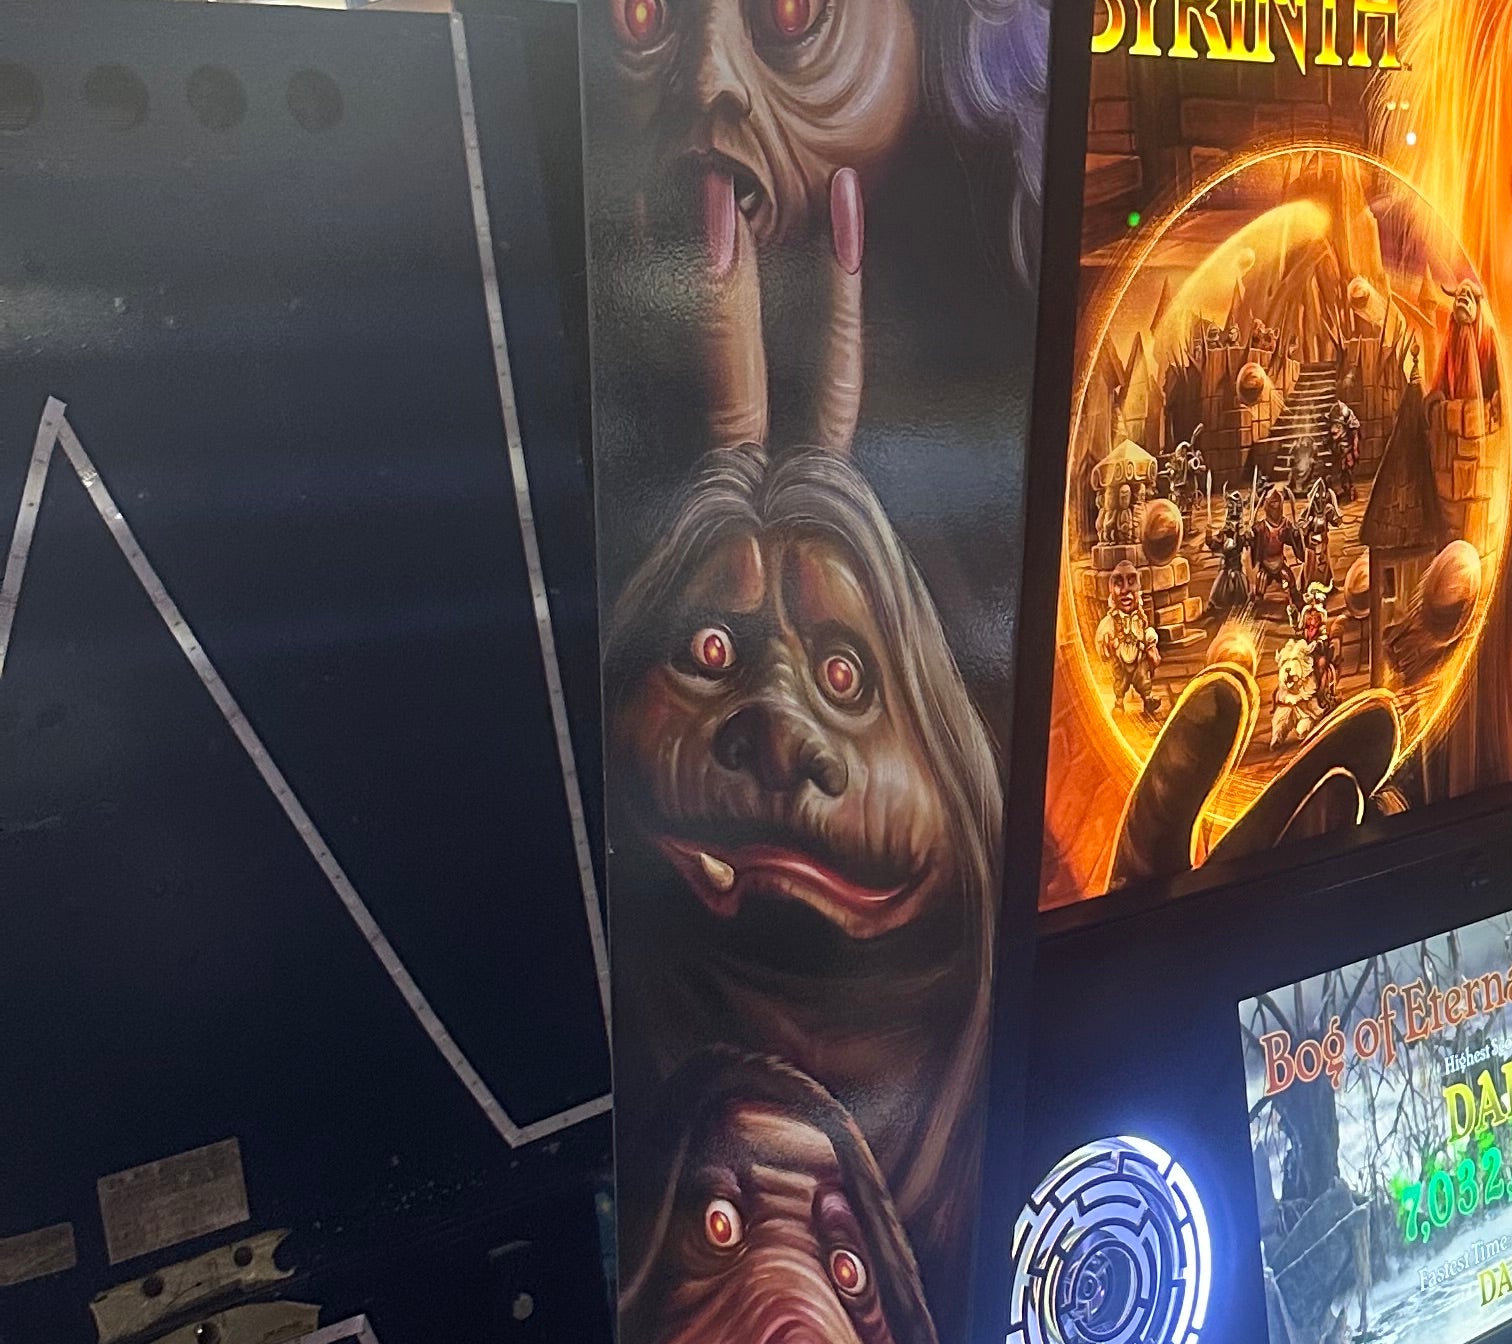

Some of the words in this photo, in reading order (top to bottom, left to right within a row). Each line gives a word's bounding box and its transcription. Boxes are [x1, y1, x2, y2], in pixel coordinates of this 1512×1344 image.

[1260, 1017, 1346, 1097] Bog
[1353, 983, 1398, 1068] of
[1444, 1046, 1492, 1075] Highest
[1417, 1256, 1470, 1291] Fastest
